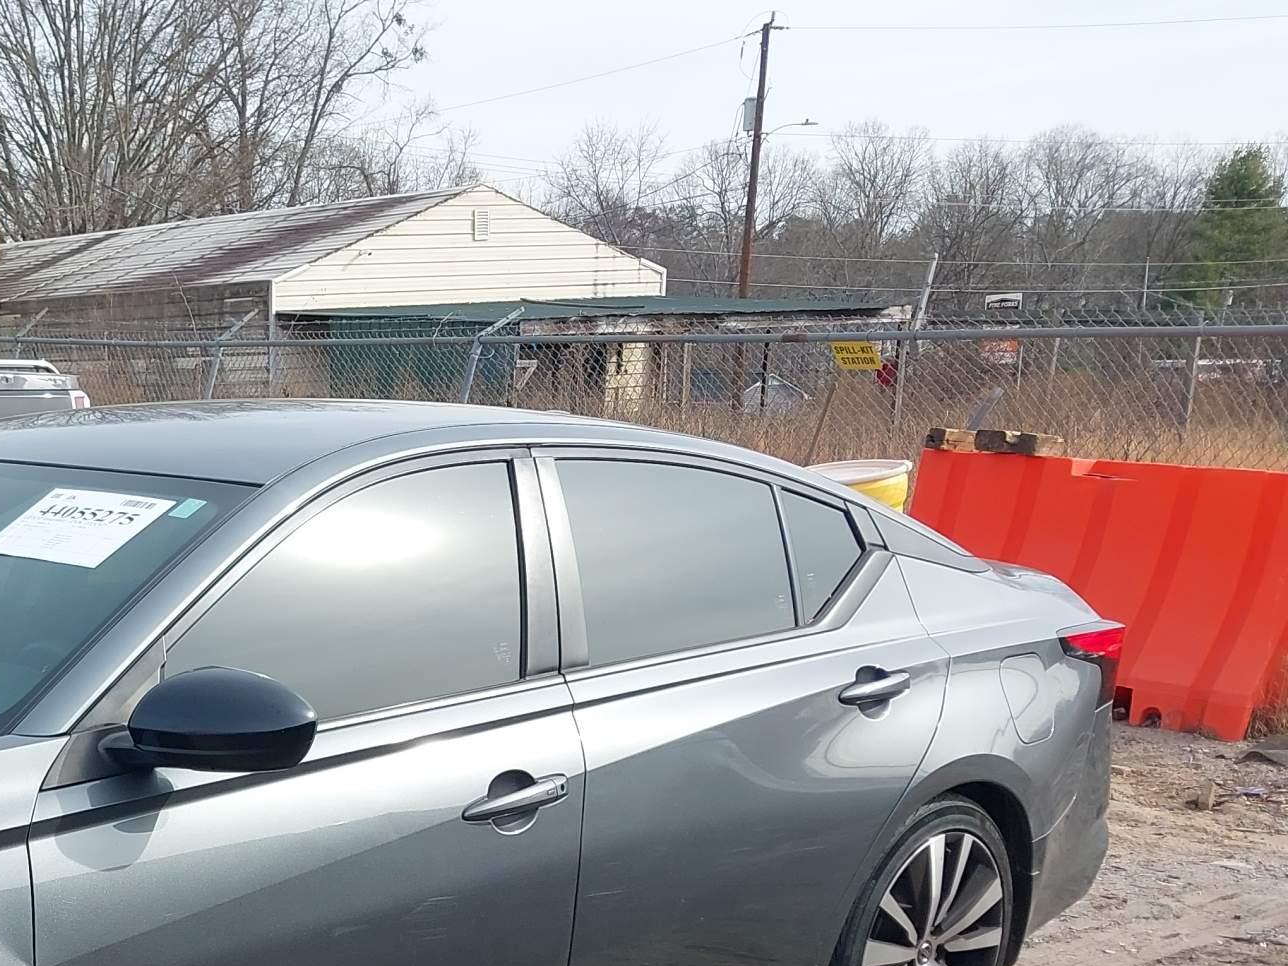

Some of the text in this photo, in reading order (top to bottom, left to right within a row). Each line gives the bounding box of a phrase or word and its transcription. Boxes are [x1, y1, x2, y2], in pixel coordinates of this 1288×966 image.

[834, 345, 874, 355] SPILL-KIT
[841, 356, 876, 365] STATION
[39, 503, 141, 526] 44055275
